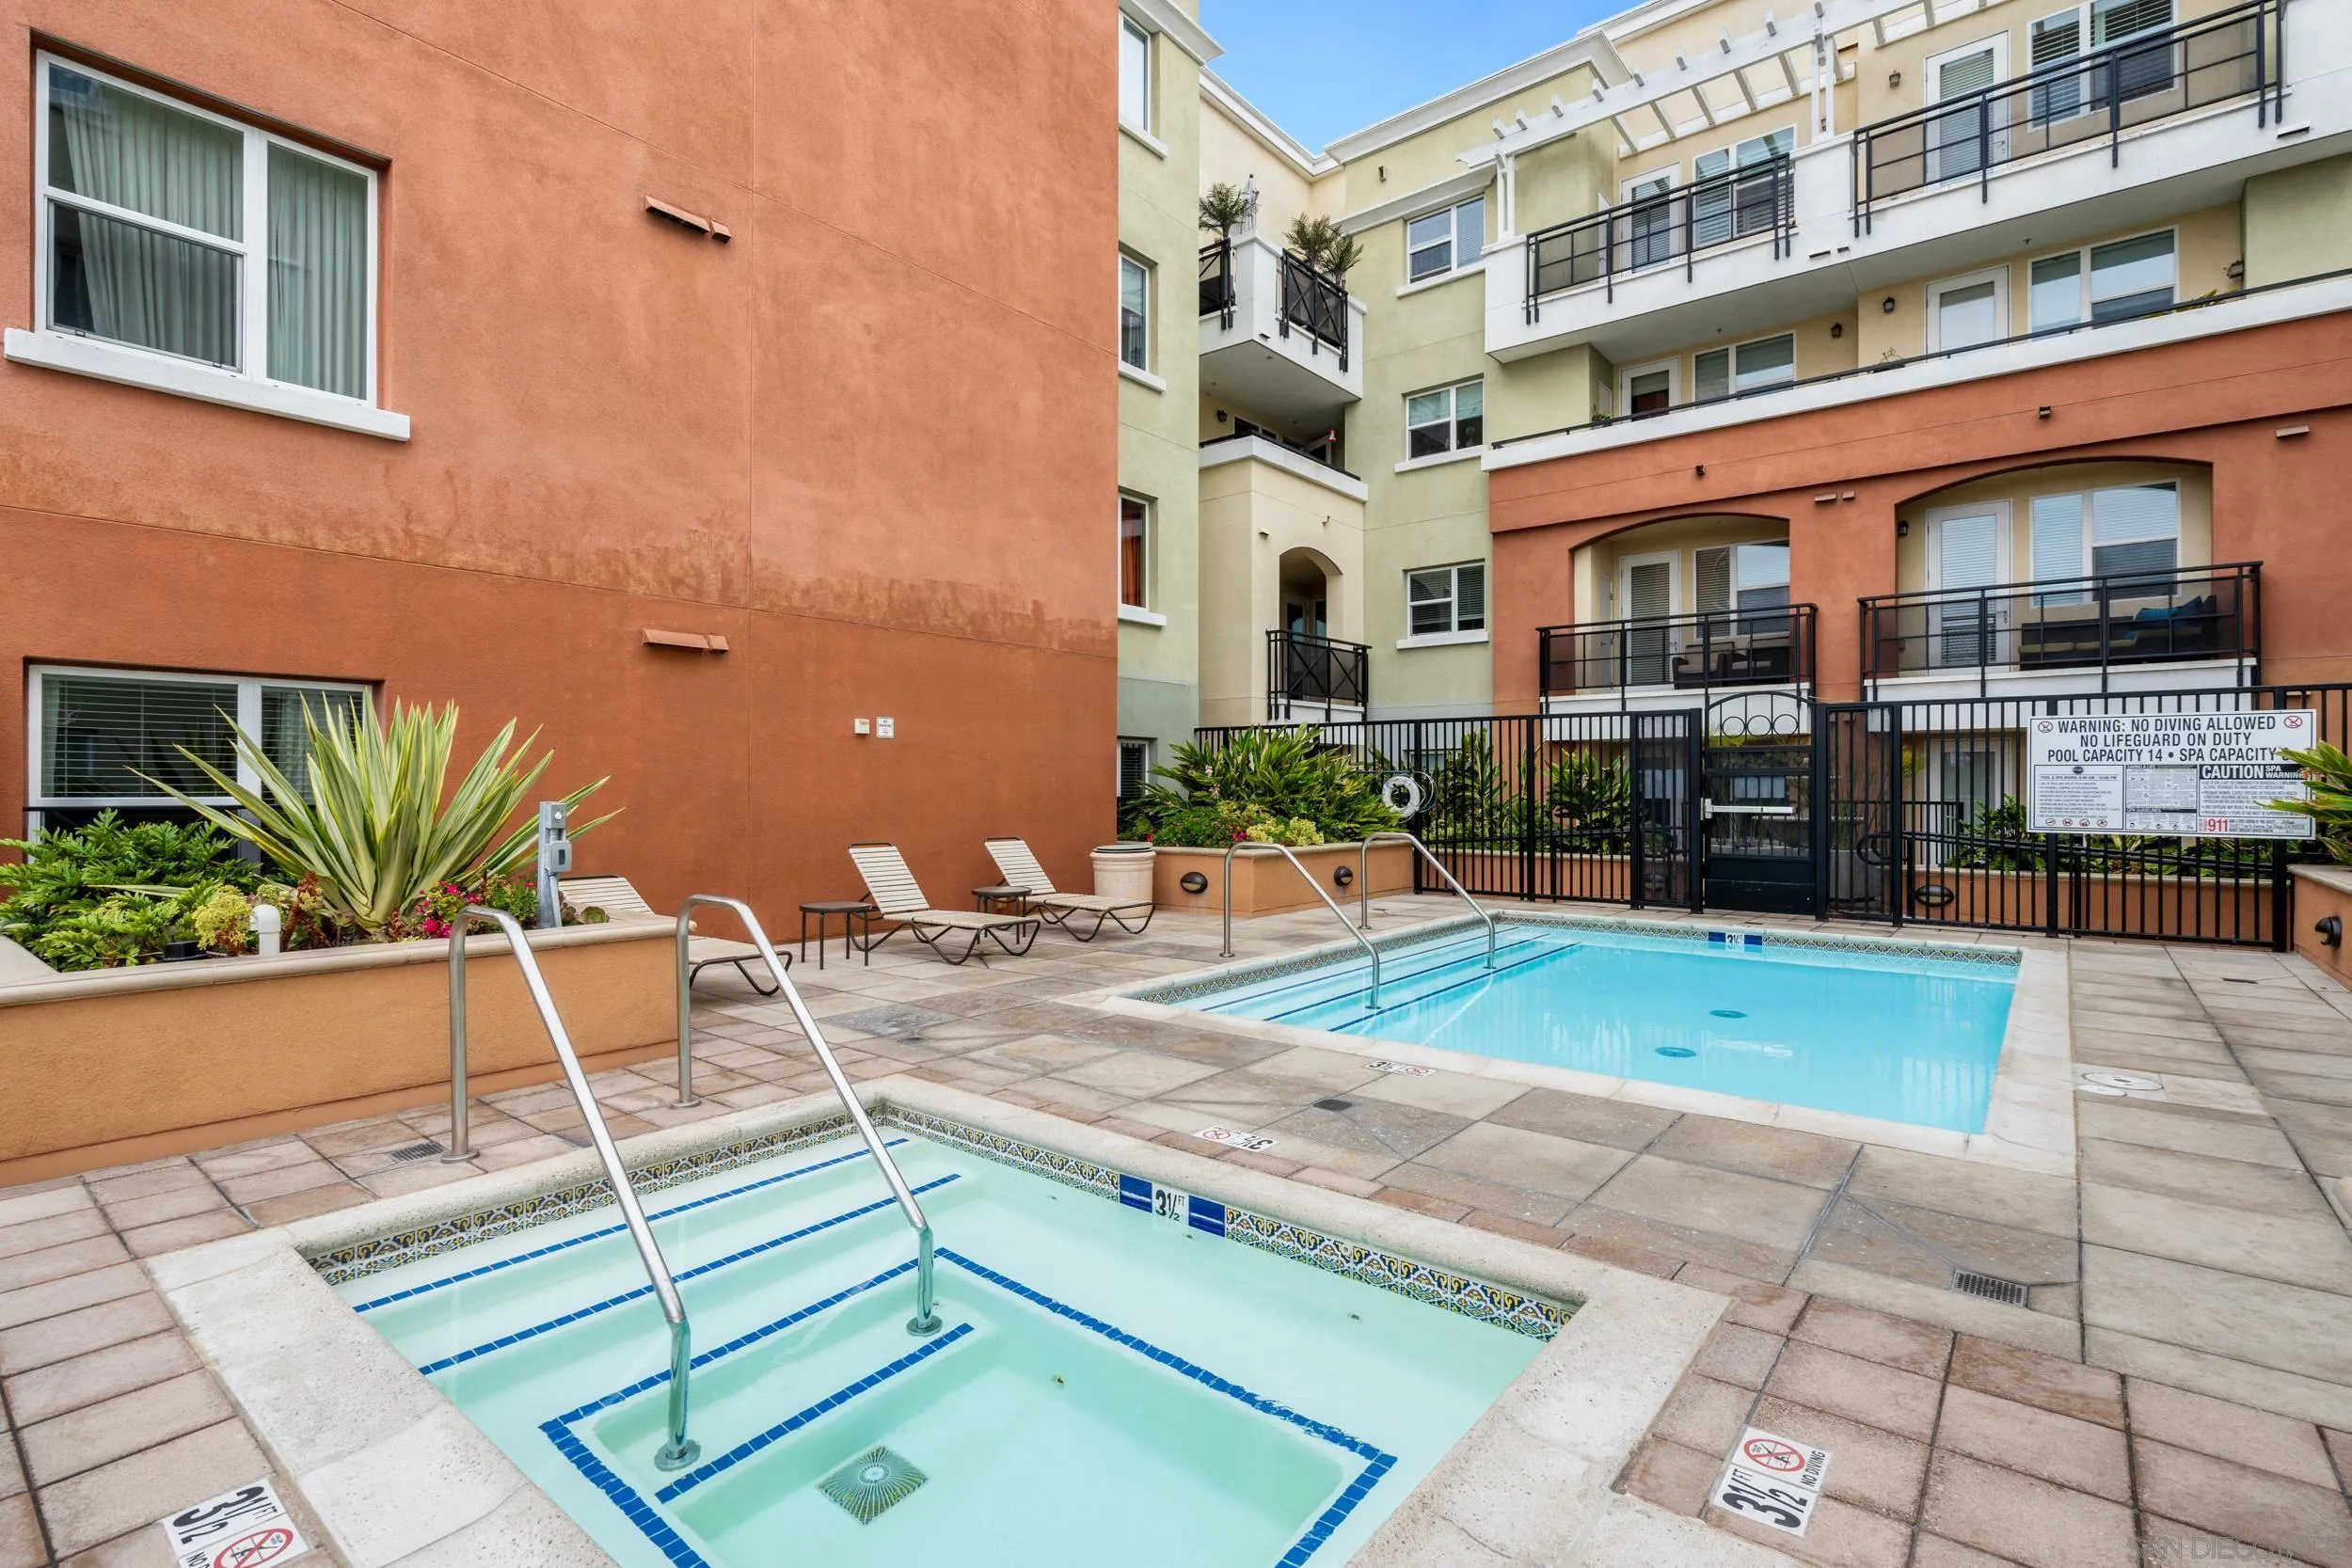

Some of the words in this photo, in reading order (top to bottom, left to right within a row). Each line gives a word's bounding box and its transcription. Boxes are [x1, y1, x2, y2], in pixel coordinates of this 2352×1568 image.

[2058, 720, 2125, 733] WARNING:
[2131, 719, 2149, 732] NO
[2154, 718, 2201, 732] DIVING
[2206, 716, 2276, 731] ALLOWED
[2080, 735, 2098, 748] NO
[2104, 734, 2180, 747] LIFEGUARD
[2187, 734, 2206, 746] ON
[2213, 732, 2251, 746] DUTY
[2048, 749, 2078, 762] POOL
[2083, 749, 2143, 762] CAPACITY
[2148, 749, 2163, 761] 14
[2179, 748, 2205, 761] SPA
[2209, 747, 2276, 761] CAPACITY
[2201, 765, 2264, 779] CAUTION
[2207, 818, 2228, 832] 911
[1178, 1195, 1185, 1207] FT
[1805, 1450, 1826, 1475] DIVING
[1801, 1474, 1818, 1487] NO
